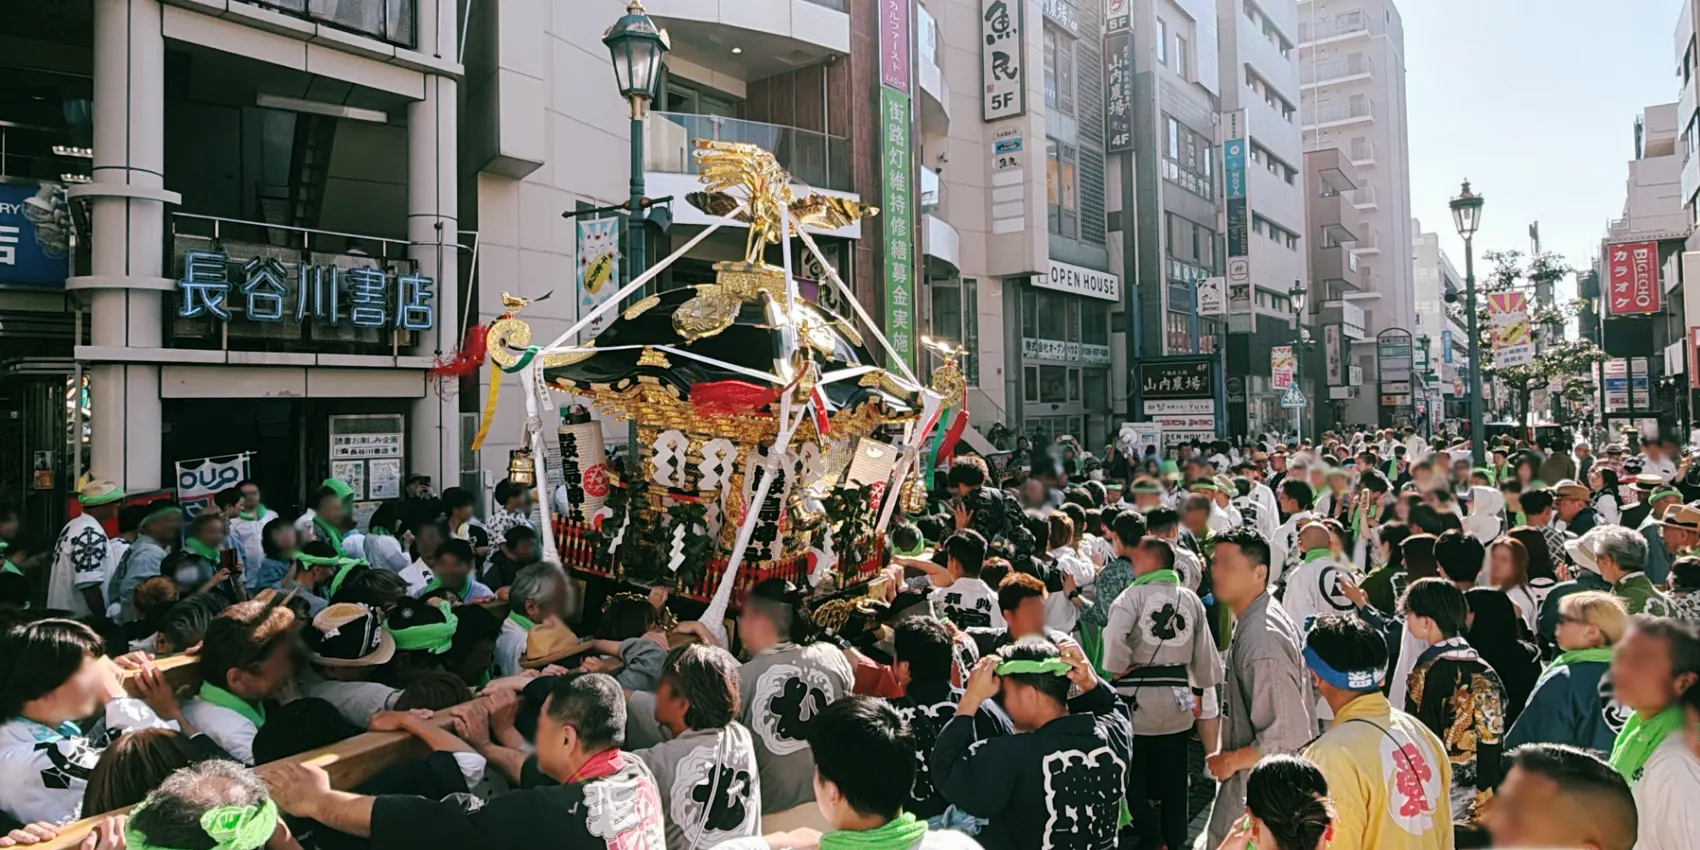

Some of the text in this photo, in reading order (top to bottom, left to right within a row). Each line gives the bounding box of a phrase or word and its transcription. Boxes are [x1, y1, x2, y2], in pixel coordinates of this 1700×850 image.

[1109, 17, 1128, 29] 5F
[985, 0, 1018, 80] 魚民
[1108, 54, 1125, 116] 山内農場
[991, 92, 1013, 110] 5F
[1112, 133, 1130, 146] 4F
[1051, 266, 1115, 295] OPEN HOUSE
[1614, 251, 1630, 308] カラオケ
[177, 248, 434, 331] 長谷川書店
[1197, 363, 1208, 371] 4F
[1143, 376, 1201, 391] 山内農場
[350, 448, 389, 456] 長谷川書店
